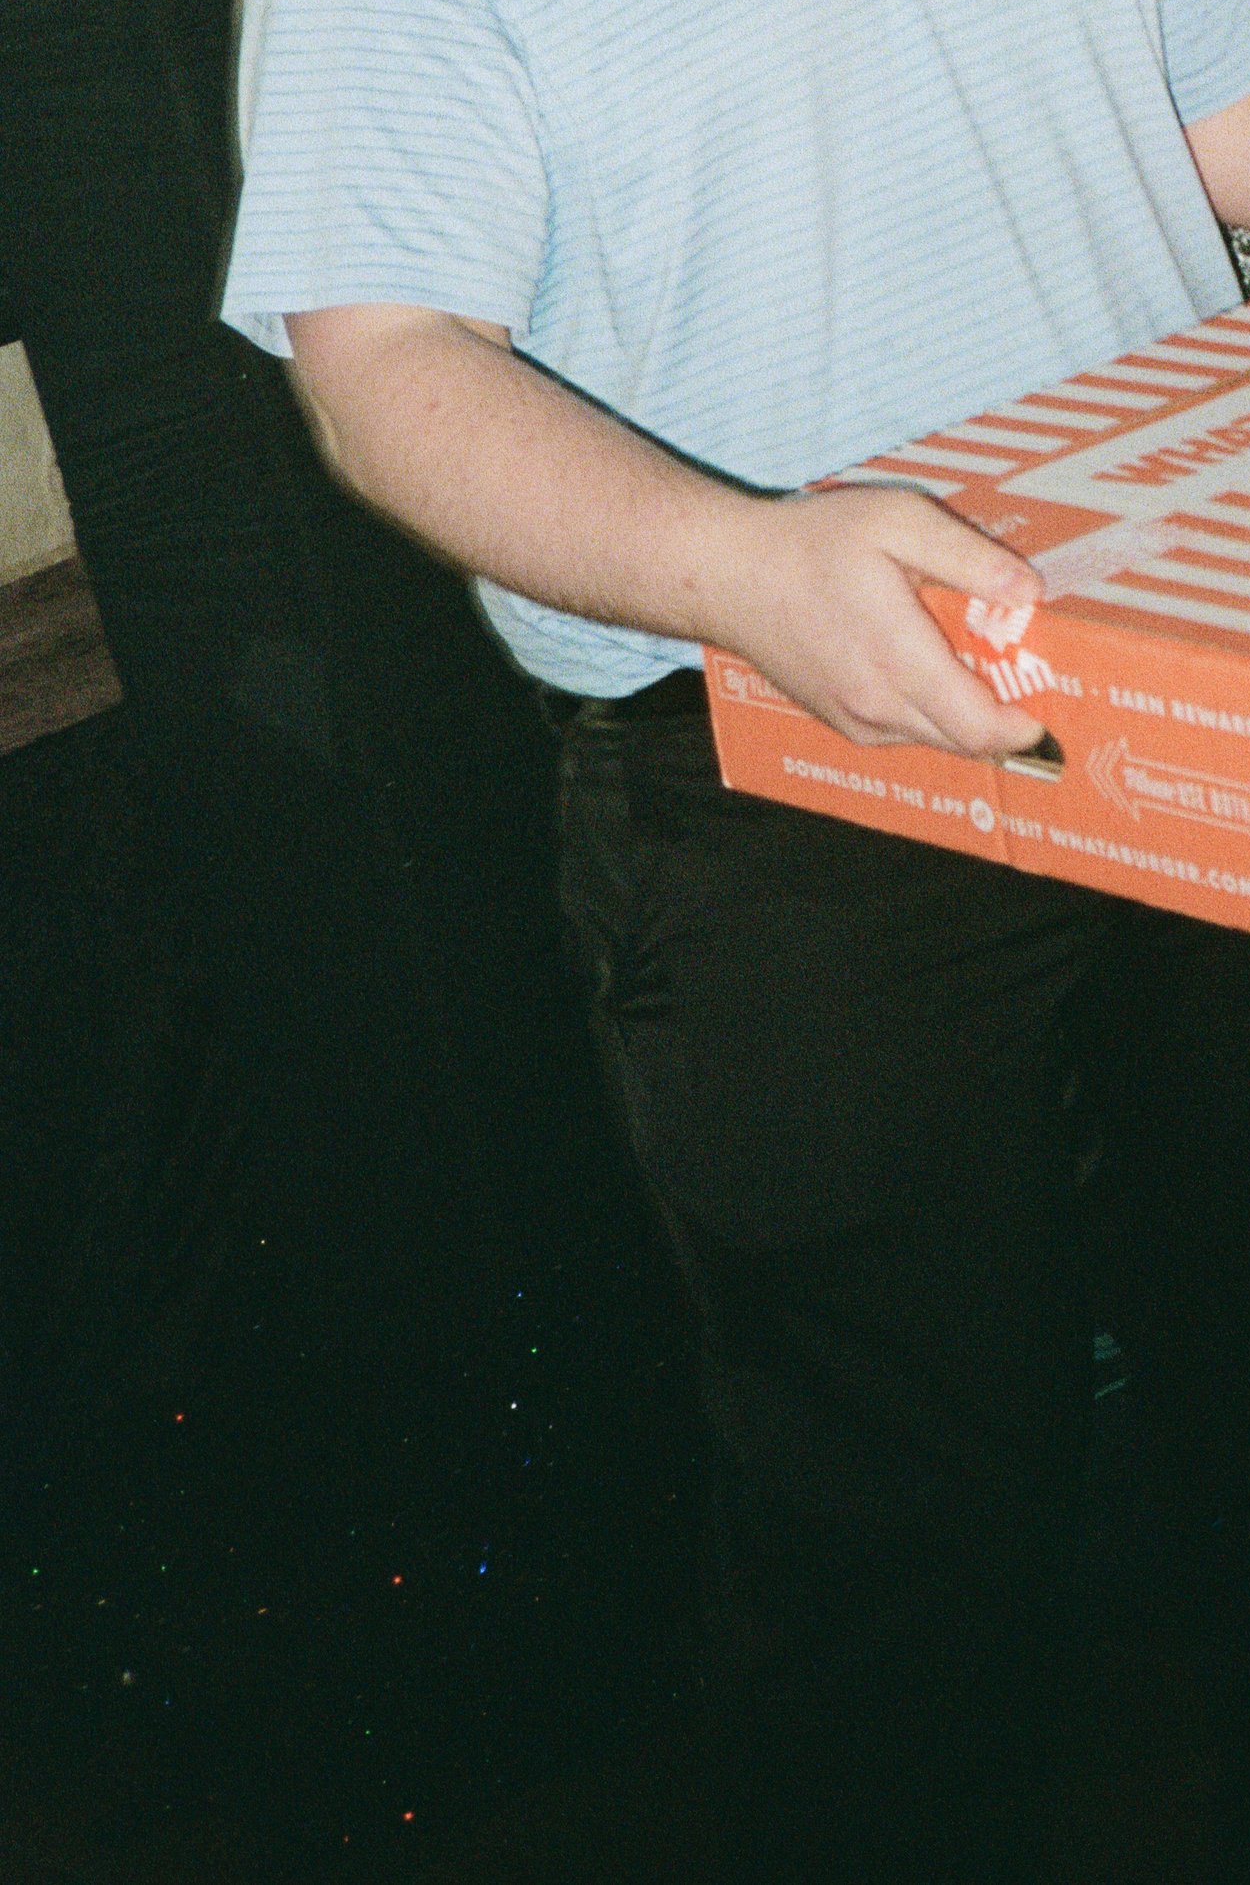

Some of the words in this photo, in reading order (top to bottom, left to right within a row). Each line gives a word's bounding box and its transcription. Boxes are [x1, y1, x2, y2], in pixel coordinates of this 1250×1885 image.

[1107, 685, 1165, 716] EARN
[782, 755, 888, 798] DOWNLOAD
[891, 782, 926, 811] THE
[930, 793, 967, 819] APP
[1001, 813, 1043, 840] VISIT
